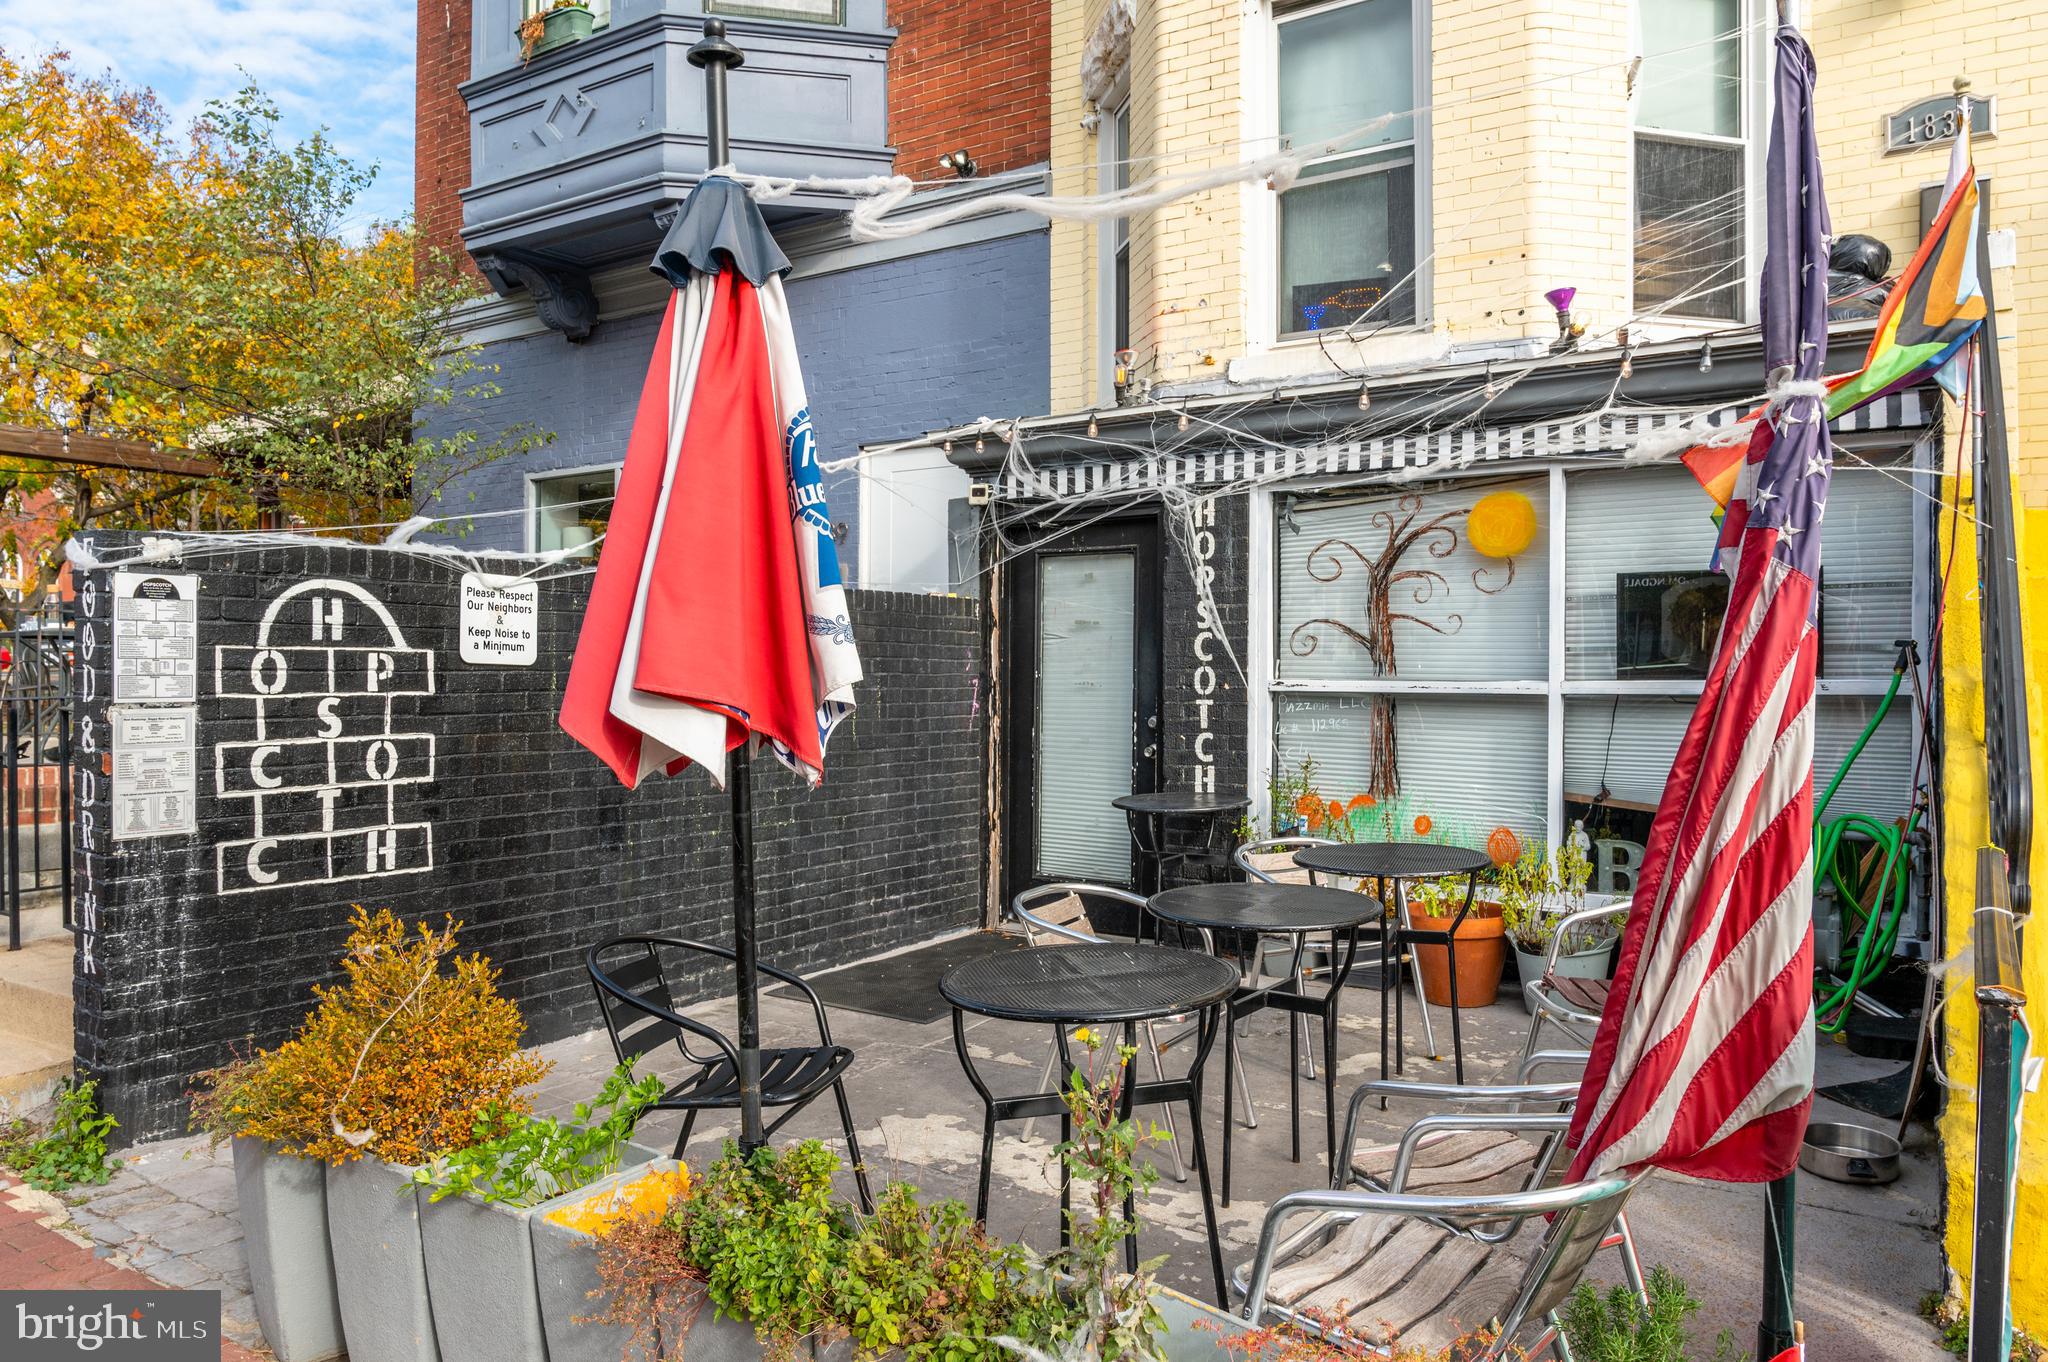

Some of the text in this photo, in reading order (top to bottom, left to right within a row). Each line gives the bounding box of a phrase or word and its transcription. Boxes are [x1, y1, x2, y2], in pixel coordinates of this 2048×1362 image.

[466, 586, 534, 602] Please Respect
[467, 600, 532, 615] Our Neighbors
[496, 615, 504, 625] &
[468, 626, 531, 639] Keep Noise to
[473, 640, 525, 652] a Minimum
[1193, 497, 1216, 793] HOPSCOTCH
[82, 768, 97, 975] DRINK
